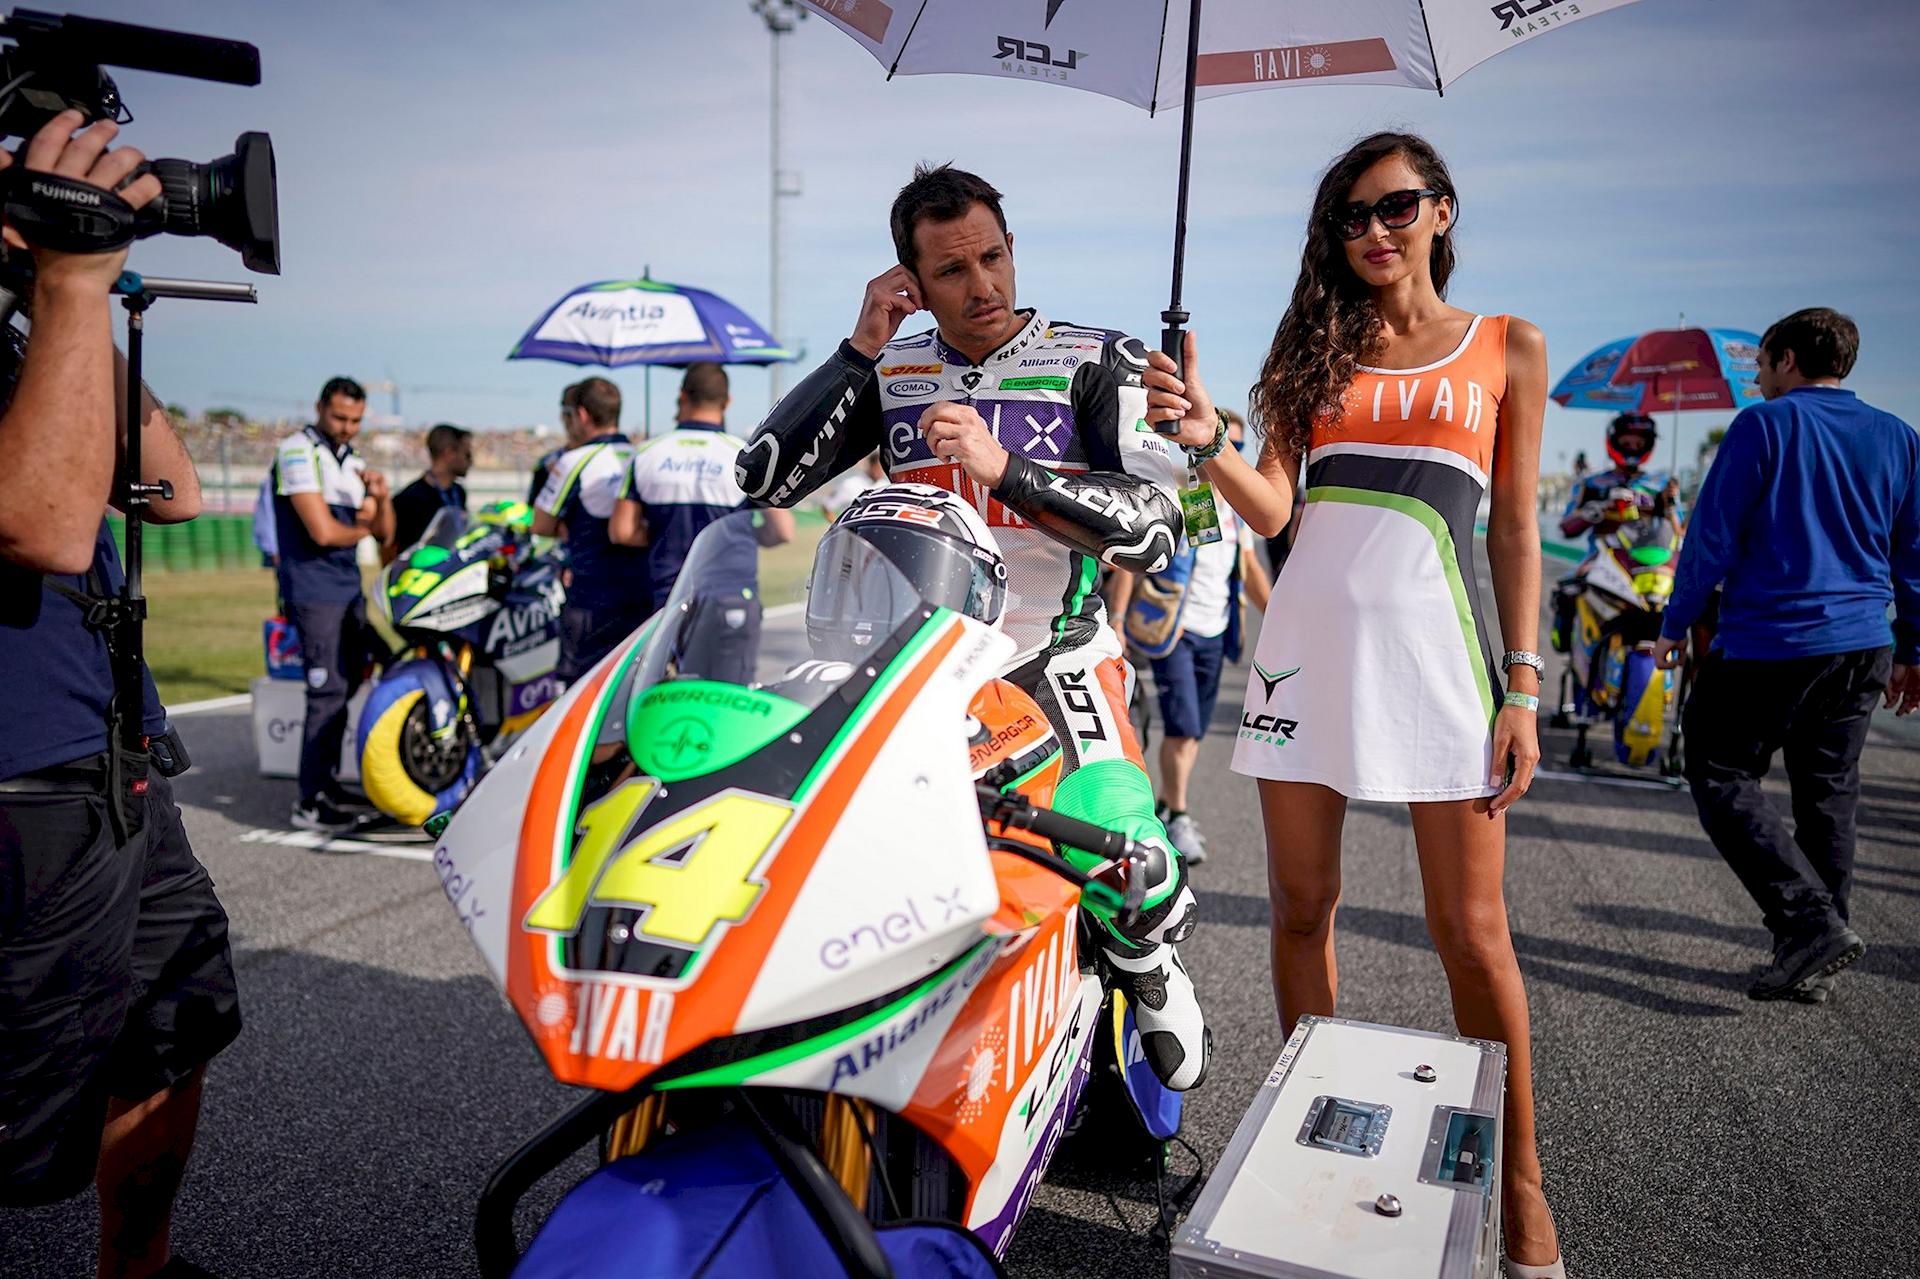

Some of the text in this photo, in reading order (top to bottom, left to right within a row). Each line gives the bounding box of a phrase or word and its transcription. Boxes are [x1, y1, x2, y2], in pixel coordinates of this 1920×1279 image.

[32, 181, 101, 206] FUJINON
[894, 383, 931, 393] COMAL
[1018, 357, 1061, 368] Allianz
[1372, 377, 1483, 433] IVAR
[1049, 476, 1141, 534] LCR
[1054, 668, 1107, 741] LCR
[1242, 711, 1299, 740] LCR
[523, 776, 798, 951] 14
[819, 897, 928, 970] enel
[567, 983, 676, 1064] IVAR
